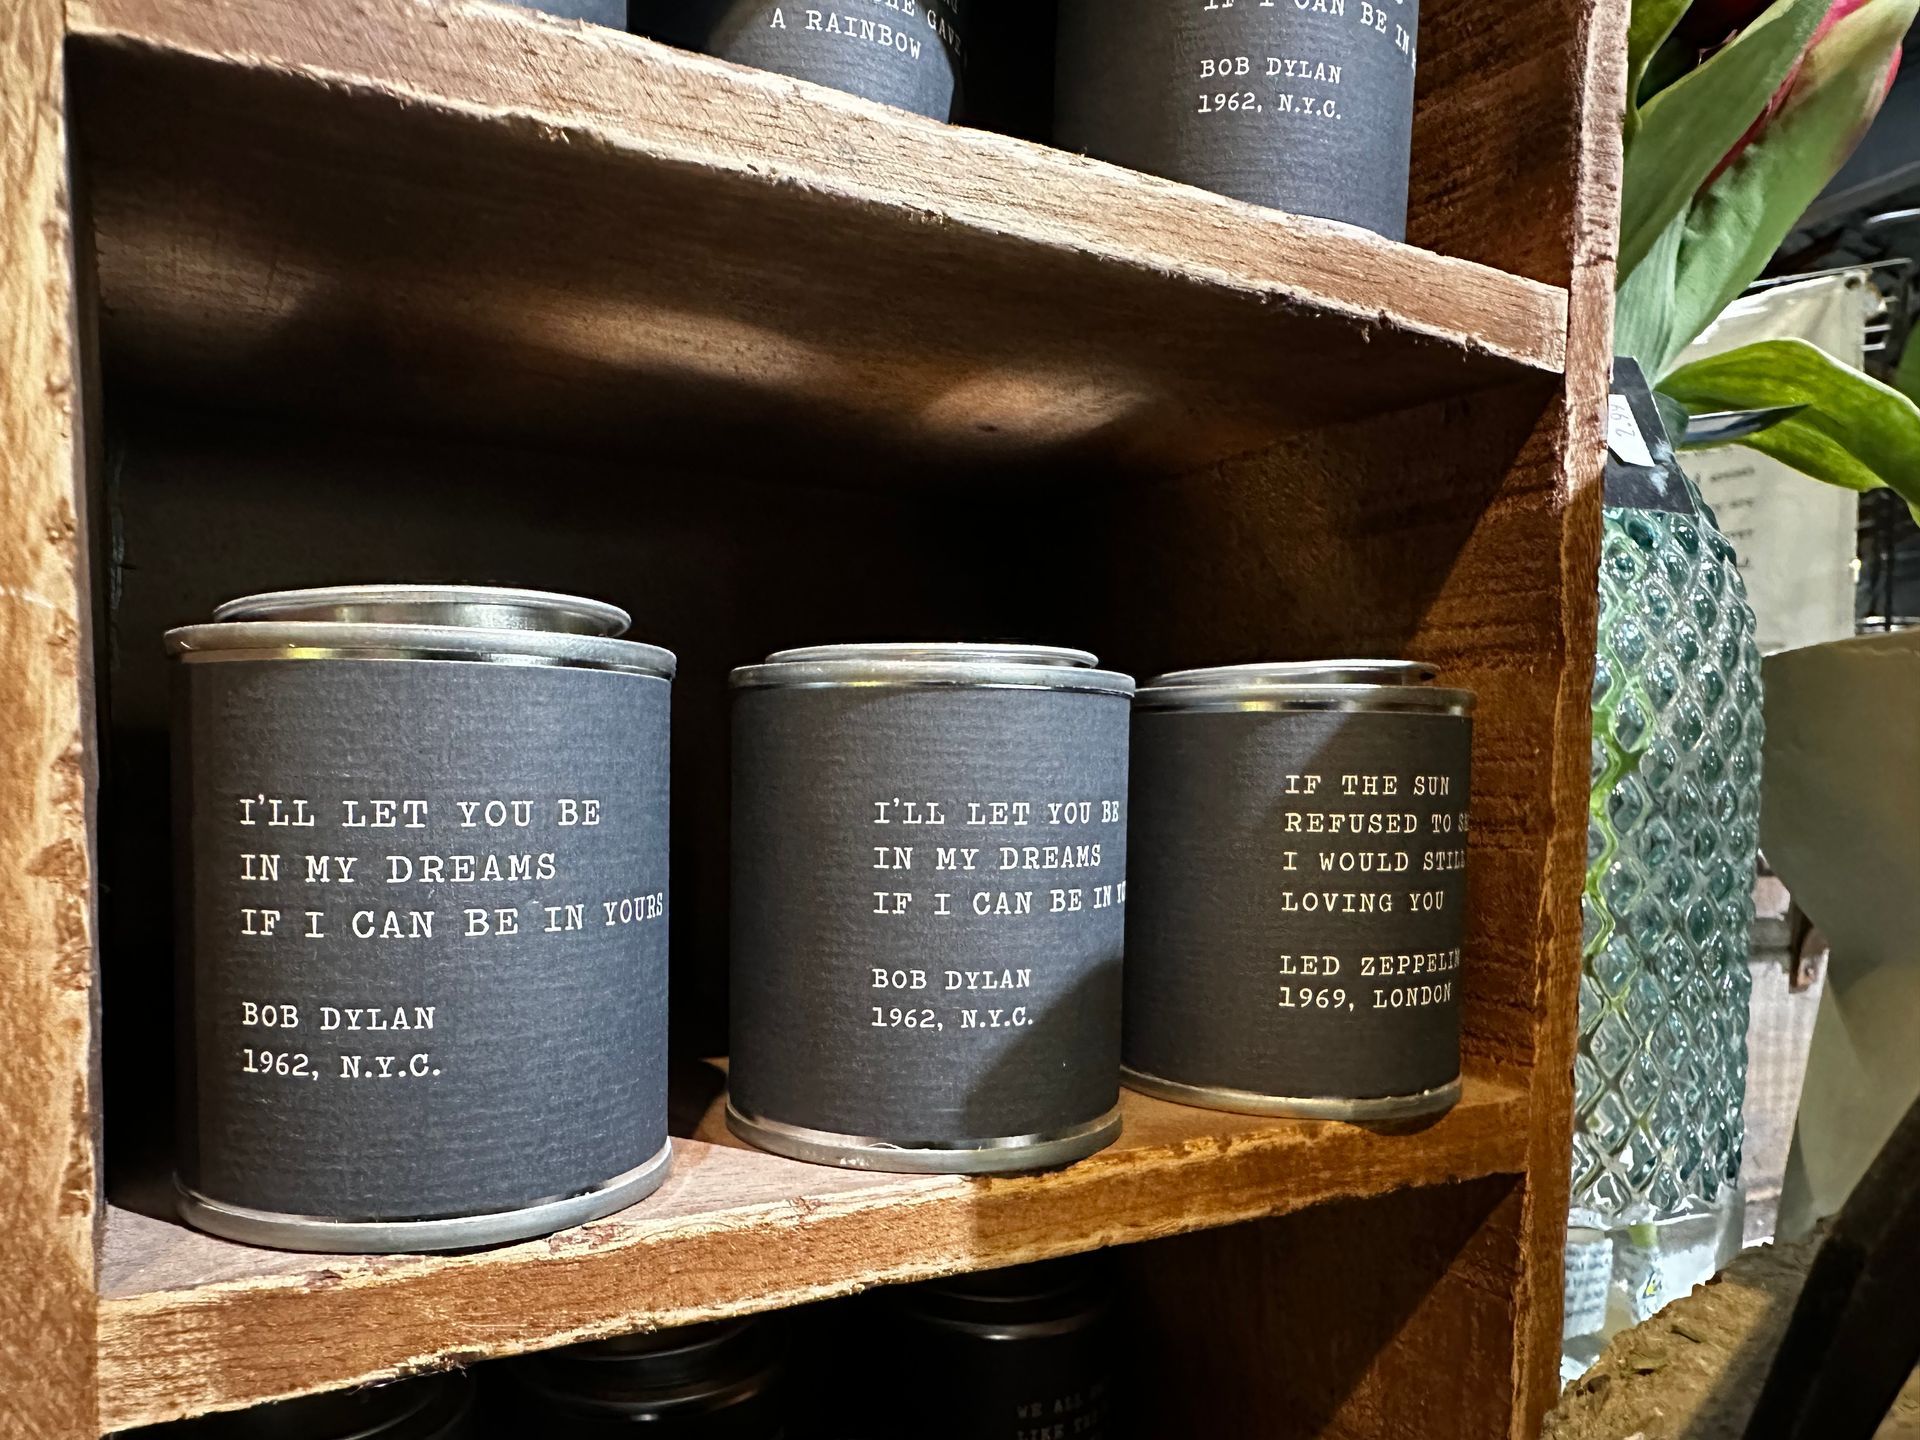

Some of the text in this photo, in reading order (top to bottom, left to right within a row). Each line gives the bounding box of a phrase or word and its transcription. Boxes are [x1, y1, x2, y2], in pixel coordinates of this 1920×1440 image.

[770, 8, 786, 29] A
[804, 9, 922, 60] RAINBOW
[1360, 2, 1386, 33] BE
[1395, 24, 1410, 55] IN
[1200, 57, 1341, 84] BOB DYLAN
[1198, 92, 1341, 119] 1962, N.Y.C.
[1286, 775, 1449, 795] IF THE SUN
[240, 794, 599, 828] I'LL LET YOU BE
[874, 798, 1119, 825] I'LL LET YOU BE
[1285, 813, 1417, 833] REFUSED
[1432, 814, 1451, 832] TO
[241, 853, 555, 883] IN MY DREAMS
[874, 845, 1100, 870] IN MY DREAMS
[1284, 852, 1297, 870] I
[1319, 852, 1408, 871] WOULD
[874, 892, 912, 914] IF
[934, 894, 950, 915] I
[973, 892, 1032, 915] CAN
[1050, 889, 1081, 912] BE
[1094, 885, 1111, 908] IN
[1282, 891, 1443, 912] LOVING YOU
[241, 893, 662, 938] IF I CAN BE IN YOURS
[1280, 947, 1460, 976] LED ZEPPELIN
[872, 969, 1031, 989] BOB DYLAN
[1279, 980, 1452, 1011] 1969, LONDON
[243, 1002, 435, 1030] BOB DYLAN
[872, 1007, 1033, 1031] 1962, N.Y.C.
[244, 1049, 440, 1080] 1962, N.Y.C.
